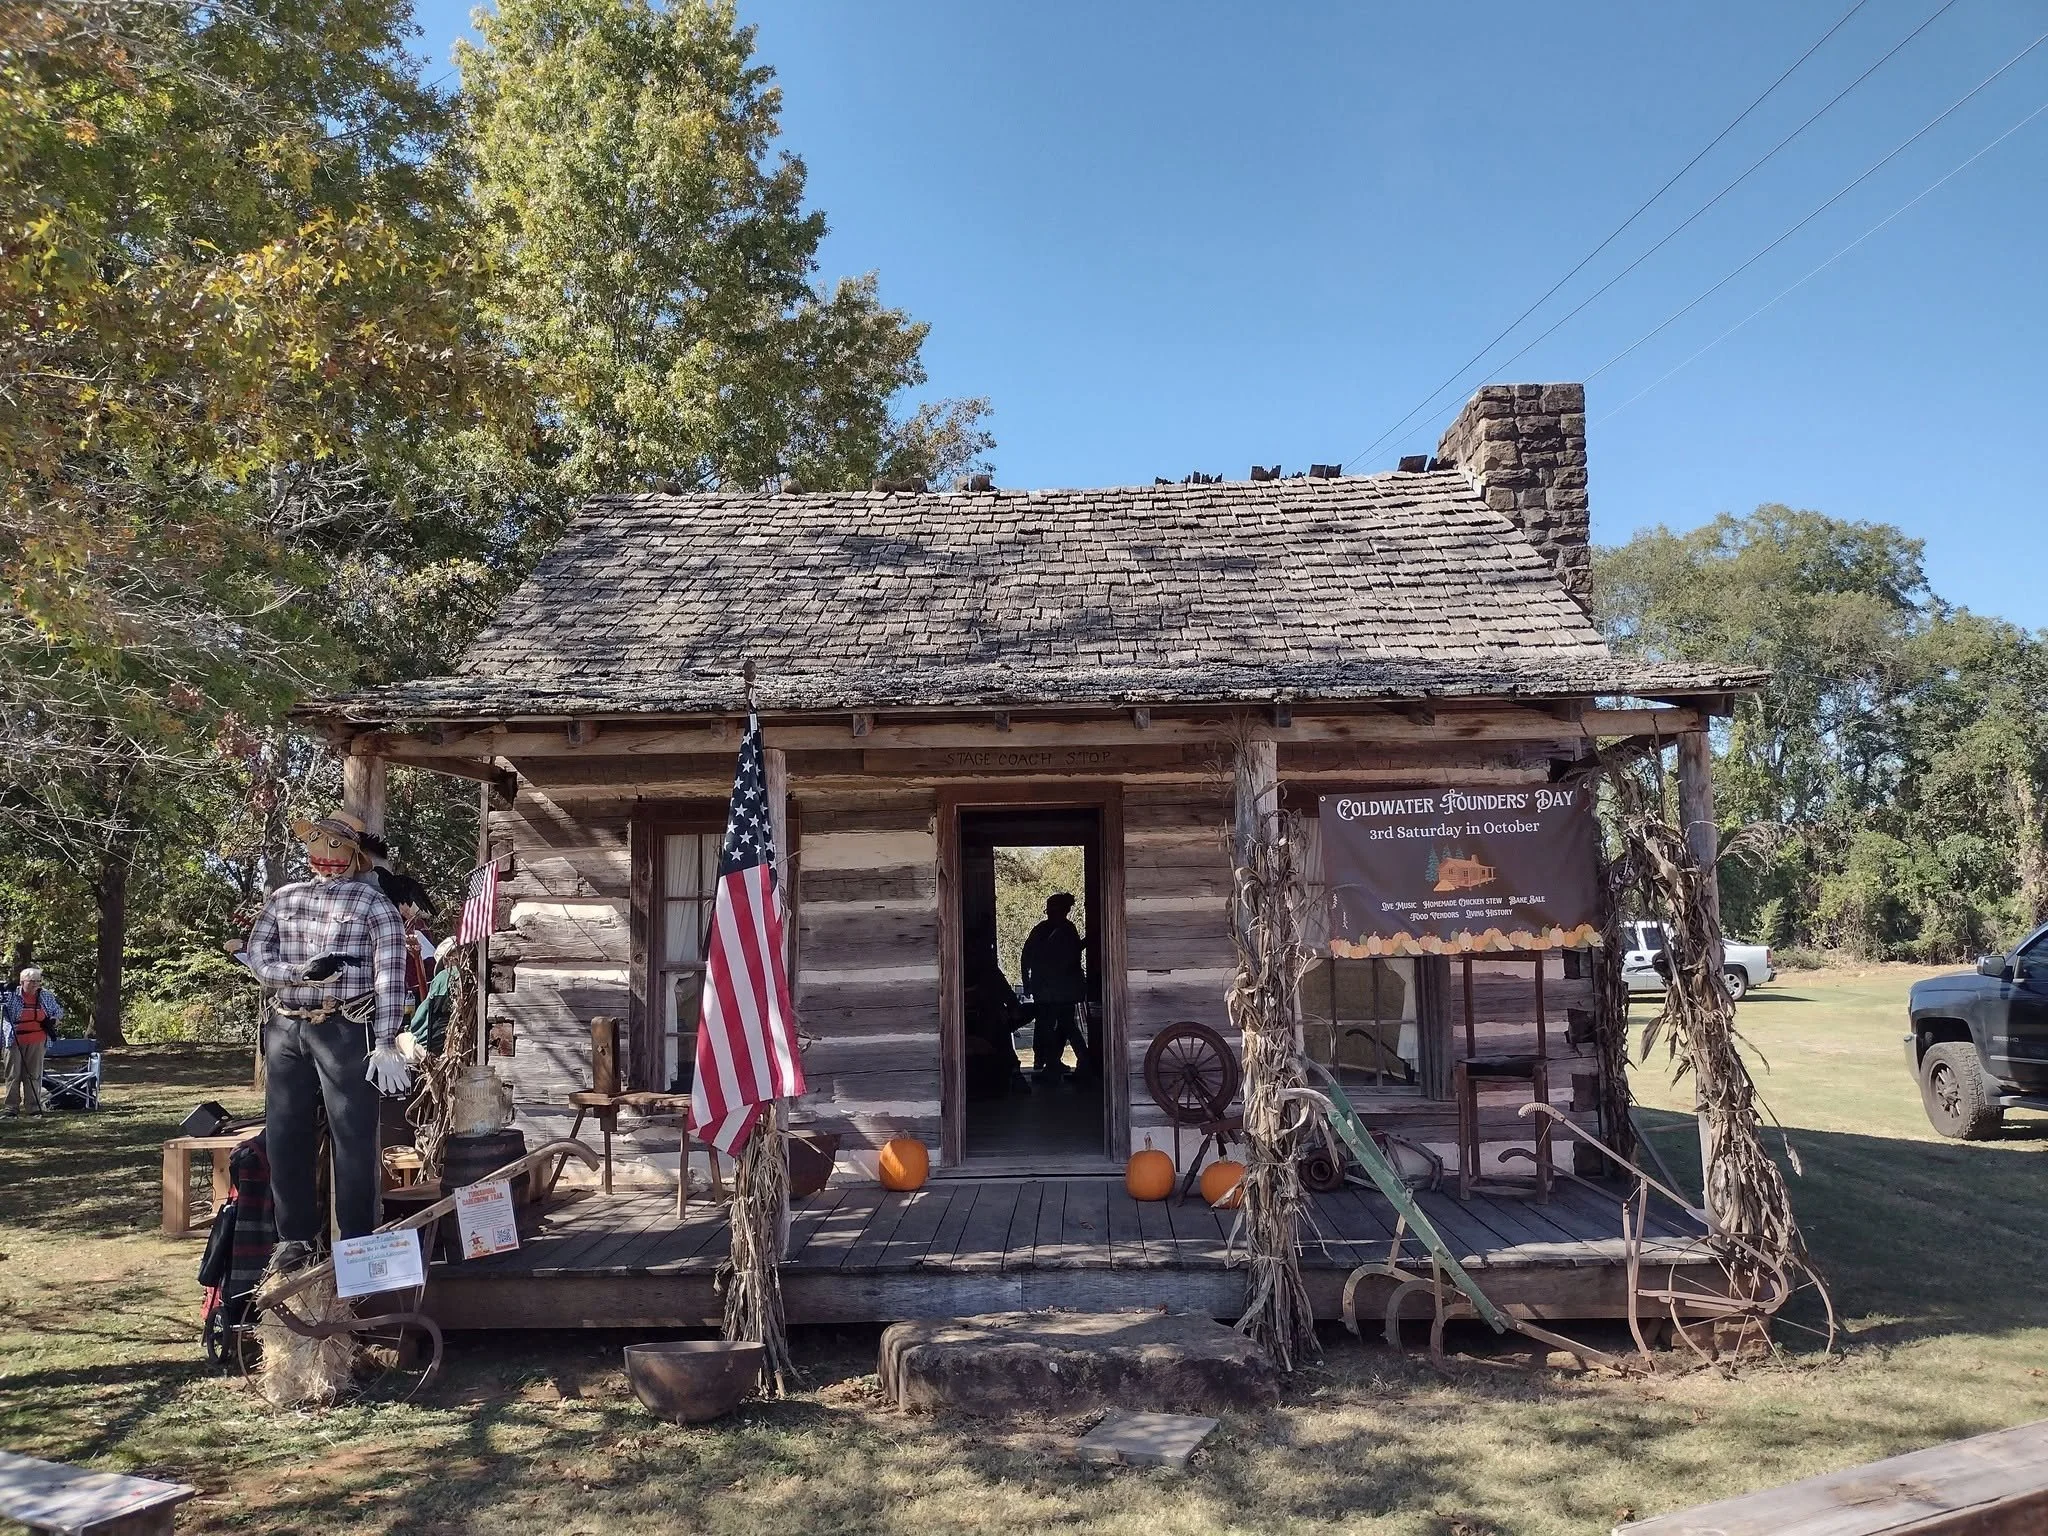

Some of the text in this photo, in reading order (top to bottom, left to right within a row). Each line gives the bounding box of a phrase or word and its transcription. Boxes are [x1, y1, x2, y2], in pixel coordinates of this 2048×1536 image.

[945, 751, 1111, 766] STAGE COACH STOP
[1336, 798, 1434, 820] COLDWATER
[1534, 789, 1574, 813] DAY
[1369, 820, 1540, 840] 3rd Saturday in October
[1381, 895, 1546, 912] LIVE MUSIC HOMEMADE CHICKEN STEW BAKE SALE
[1409, 908, 1513, 921] FOOD VENDORS LIVING HISTORY
